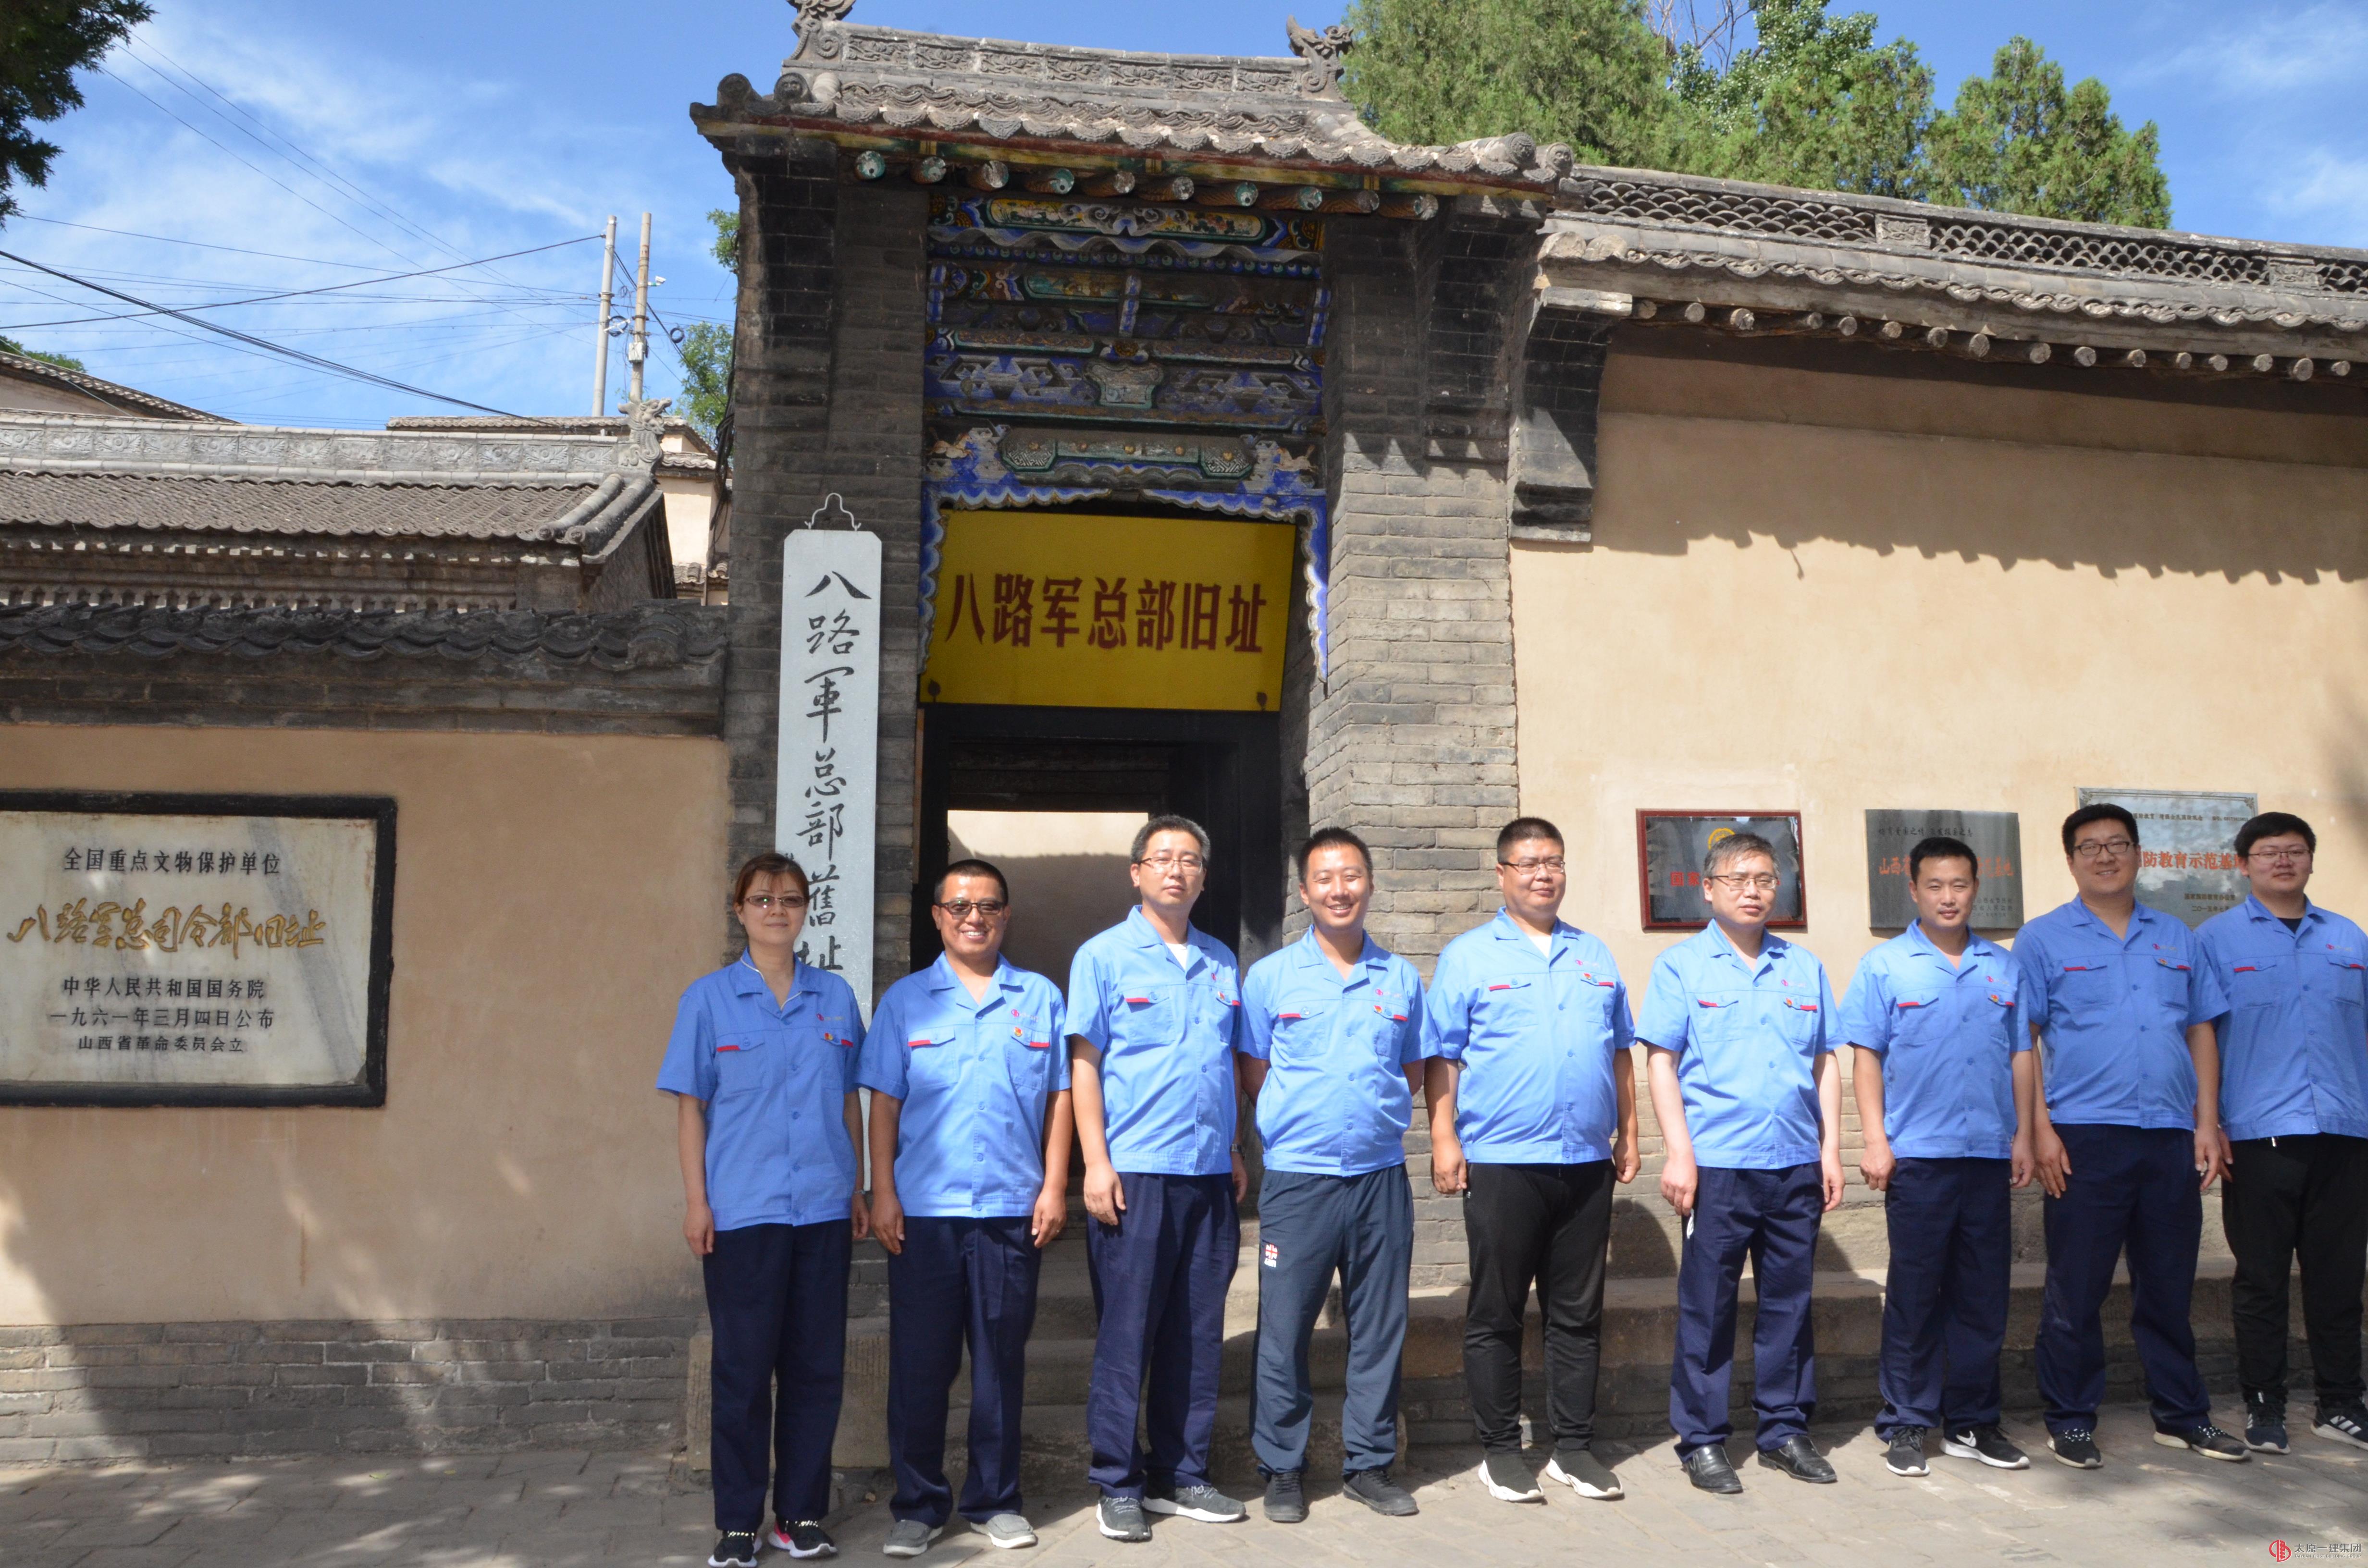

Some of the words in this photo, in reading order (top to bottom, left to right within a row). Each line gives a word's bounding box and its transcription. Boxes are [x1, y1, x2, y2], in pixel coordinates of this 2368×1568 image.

[945, 573, 1267, 652] 八路军总部旧址
[64, 847, 281, 875] 全国重点文物保护单位
[64, 977, 265, 999] 中华人民共和国国务院
[50, 1007, 274, 1029] 一九六一年三月四日公布
[78, 1035, 243, 1053] 山西省革命委员会立
